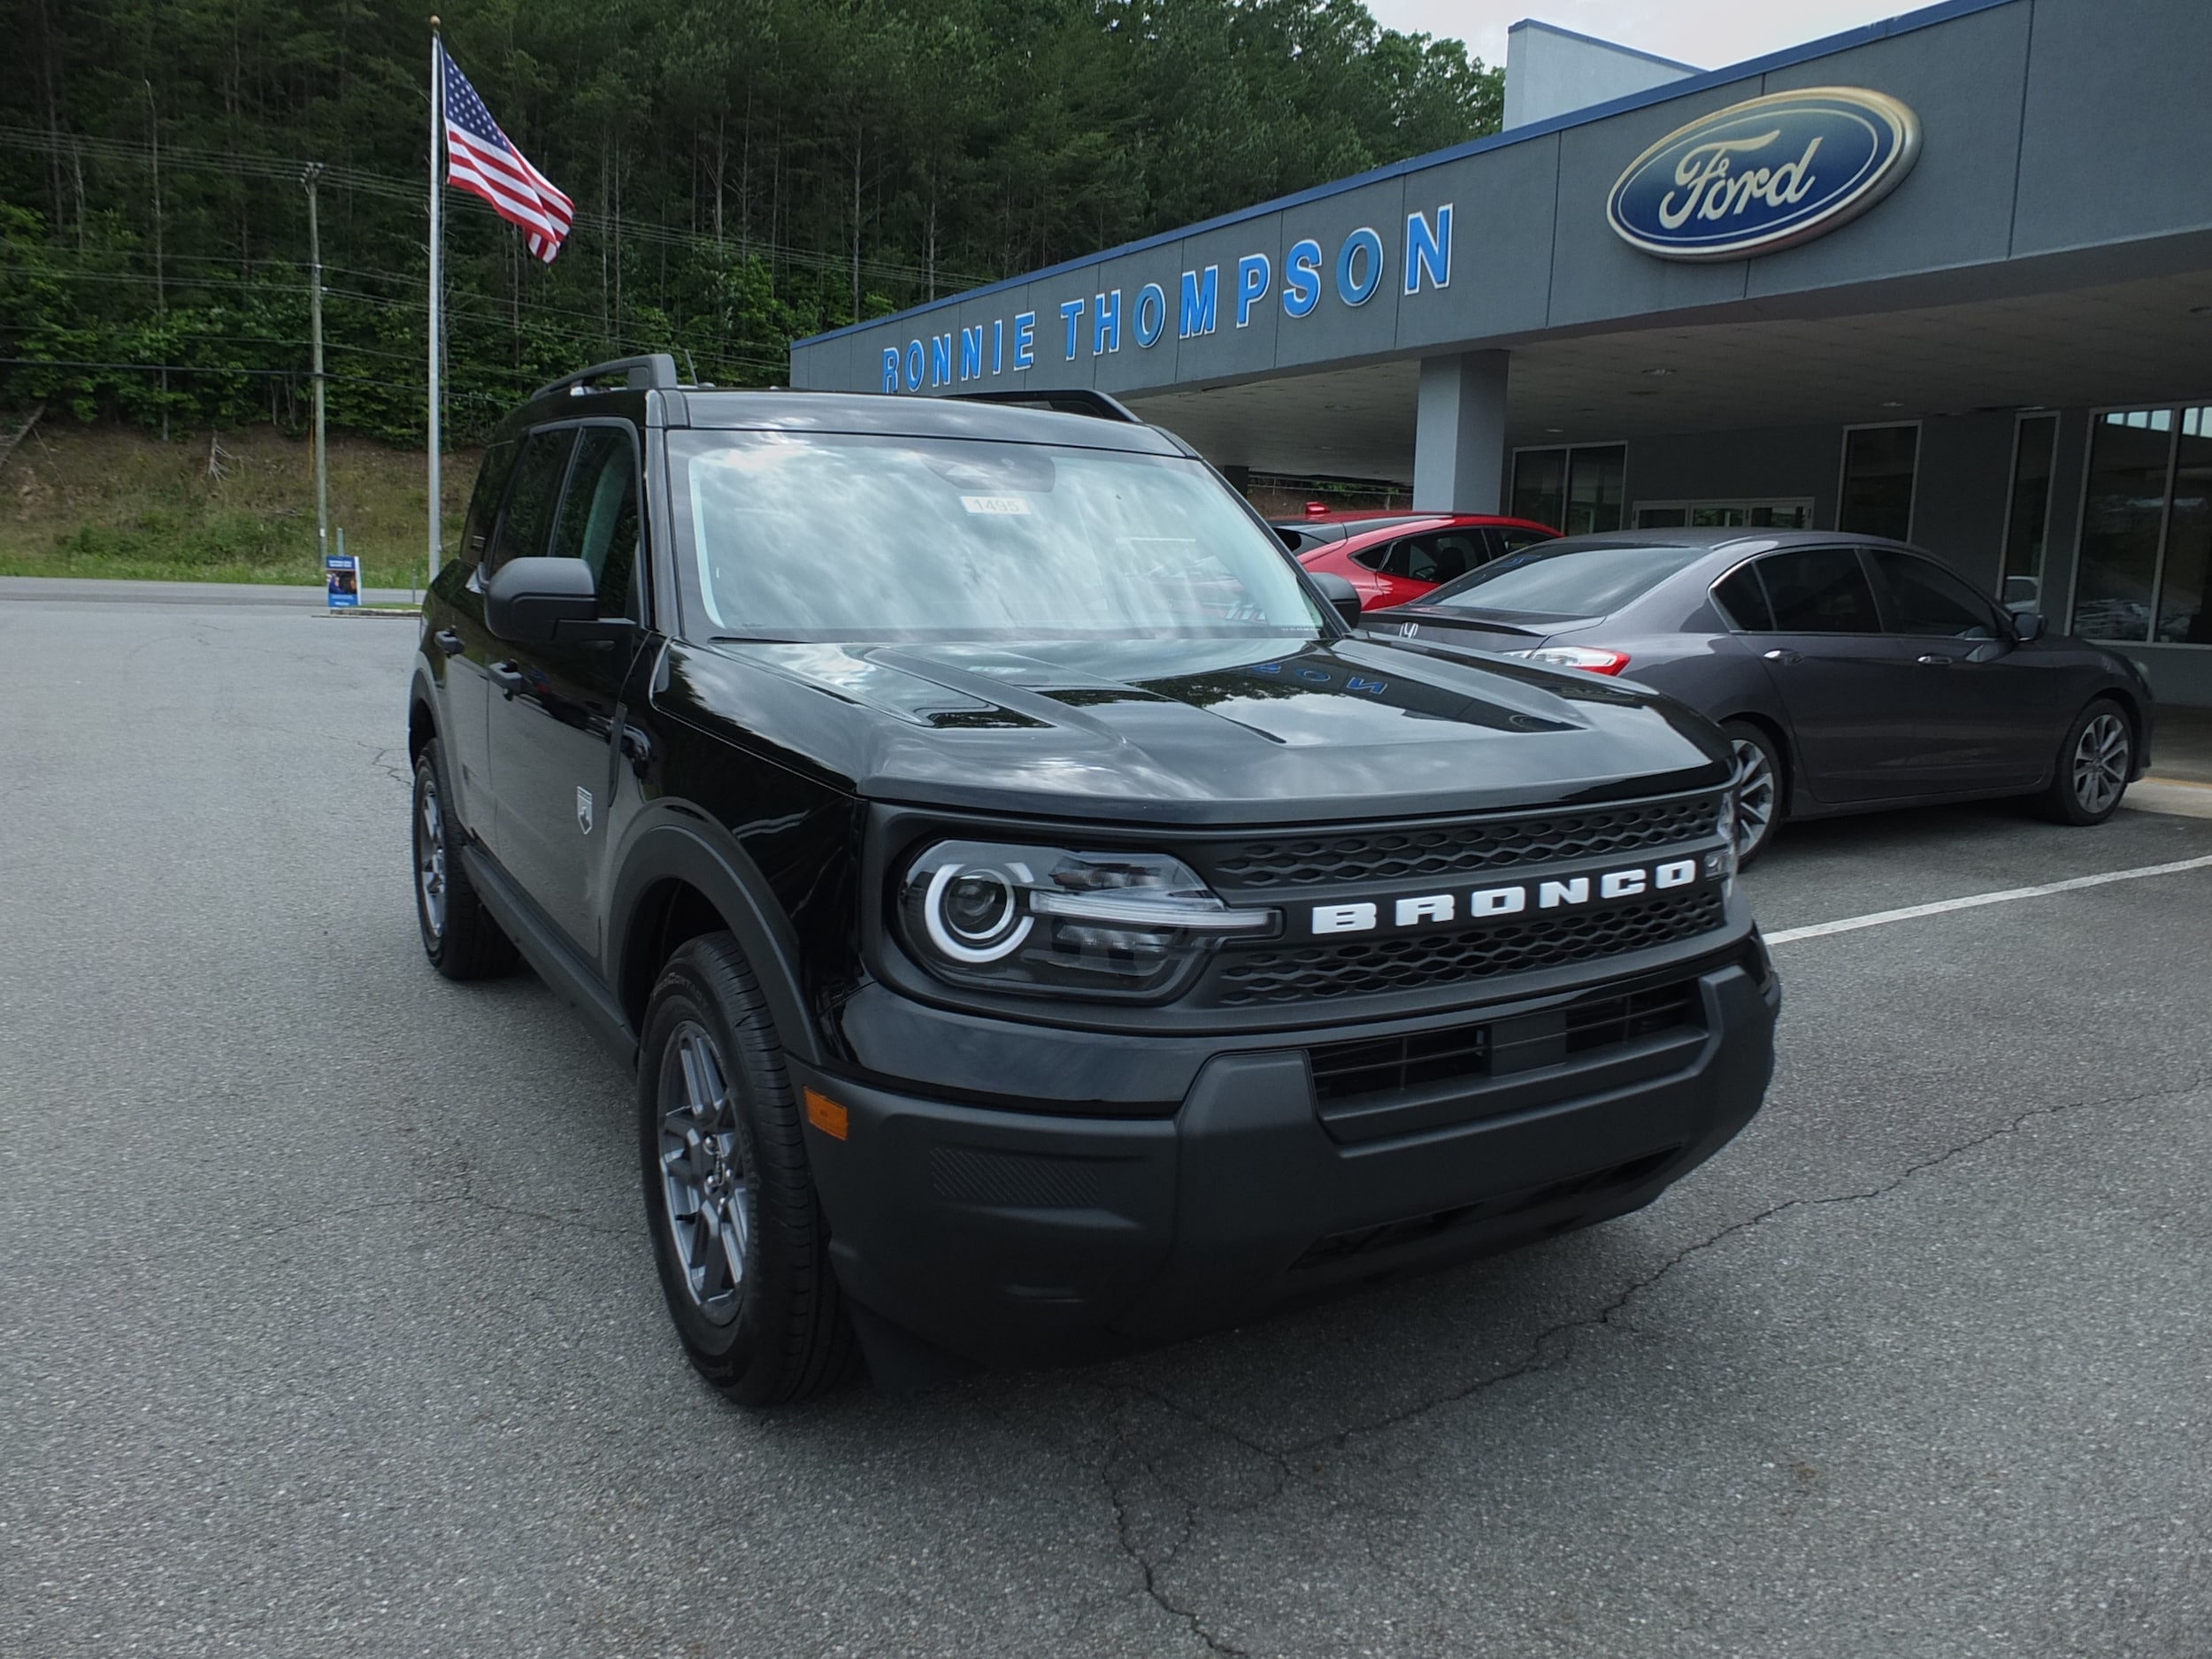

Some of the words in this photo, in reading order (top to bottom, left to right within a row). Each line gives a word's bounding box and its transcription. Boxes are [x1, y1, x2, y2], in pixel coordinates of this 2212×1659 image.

[1658, 129, 1823, 230] Ford
[882, 311, 1035, 394] RONNIE
[1060, 203, 1454, 361] THOMPSON
[973, 499, 1020, 512] 1495
[1311, 859, 1696, 935] BRONCO
